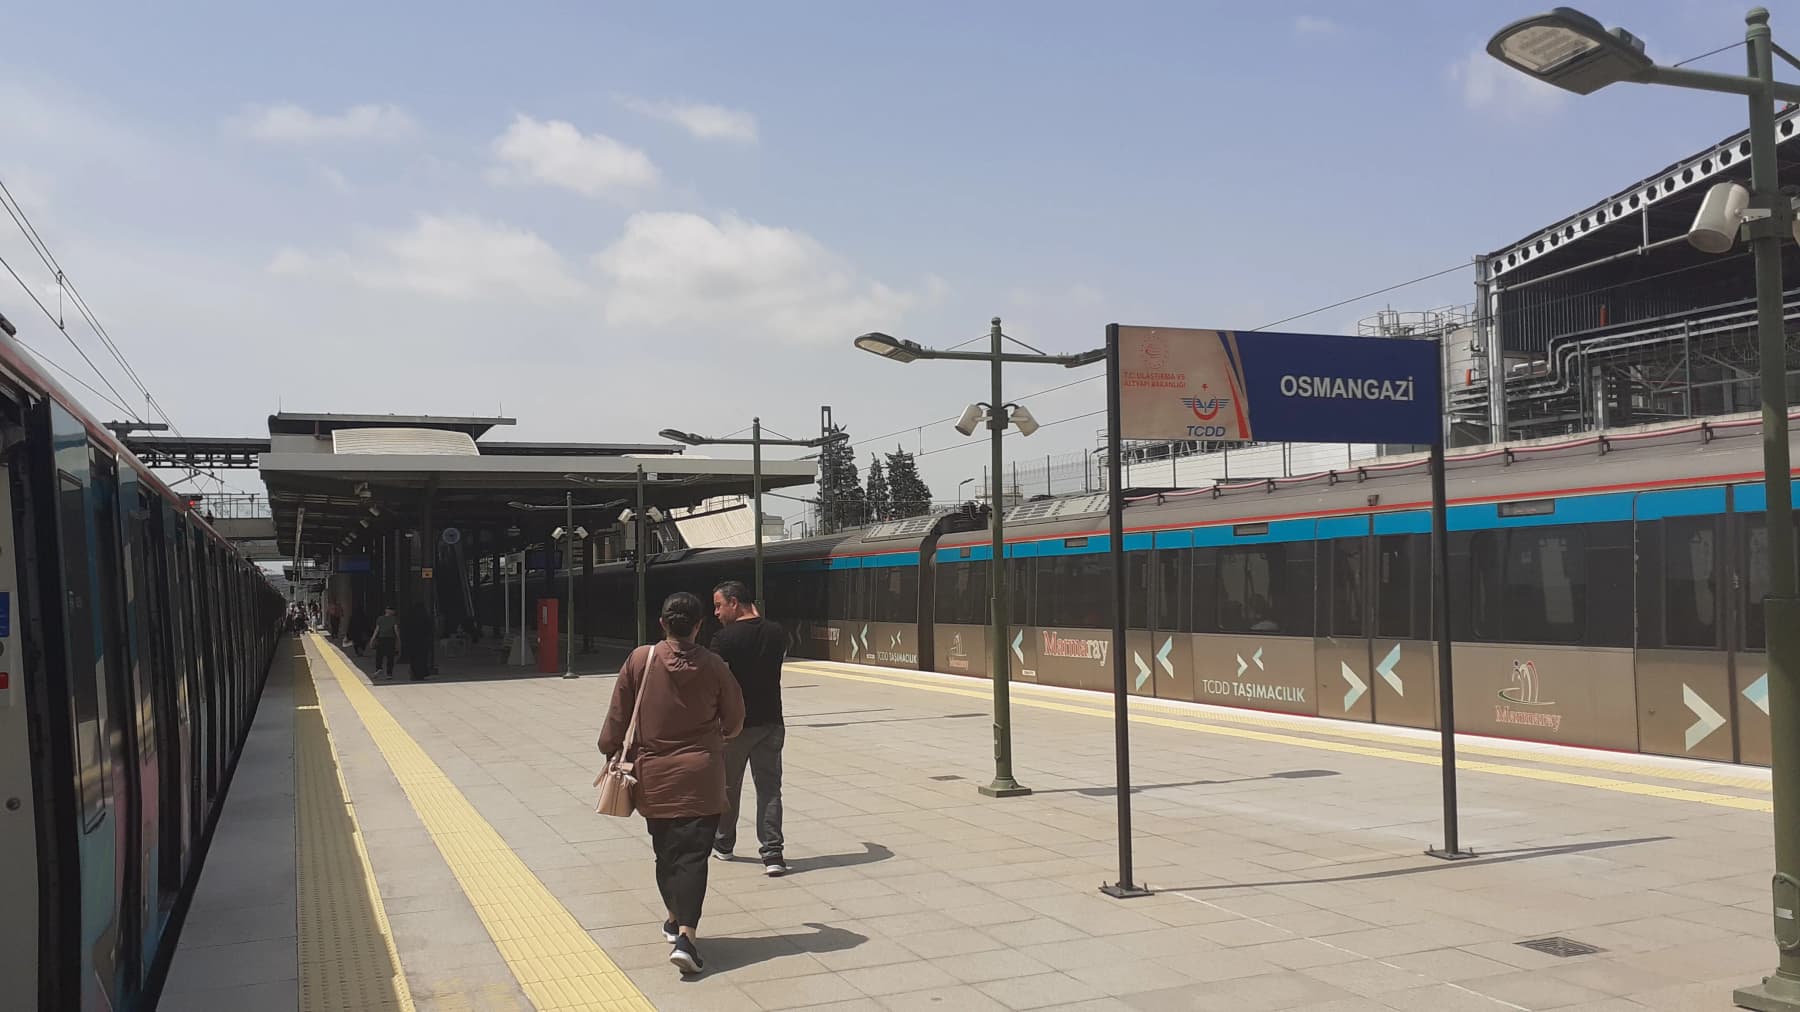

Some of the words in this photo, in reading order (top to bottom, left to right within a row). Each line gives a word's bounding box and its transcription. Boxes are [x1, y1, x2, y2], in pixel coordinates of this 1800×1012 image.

[1280, 375, 1414, 401] OSMANGAZİ
[1186, 425, 1226, 437] TCDD
[1043, 630, 1108, 667] Marmaray
[1202, 679, 1230, 695] TCDD
[1232, 681, 1305, 703] TAŞIMACILIK
